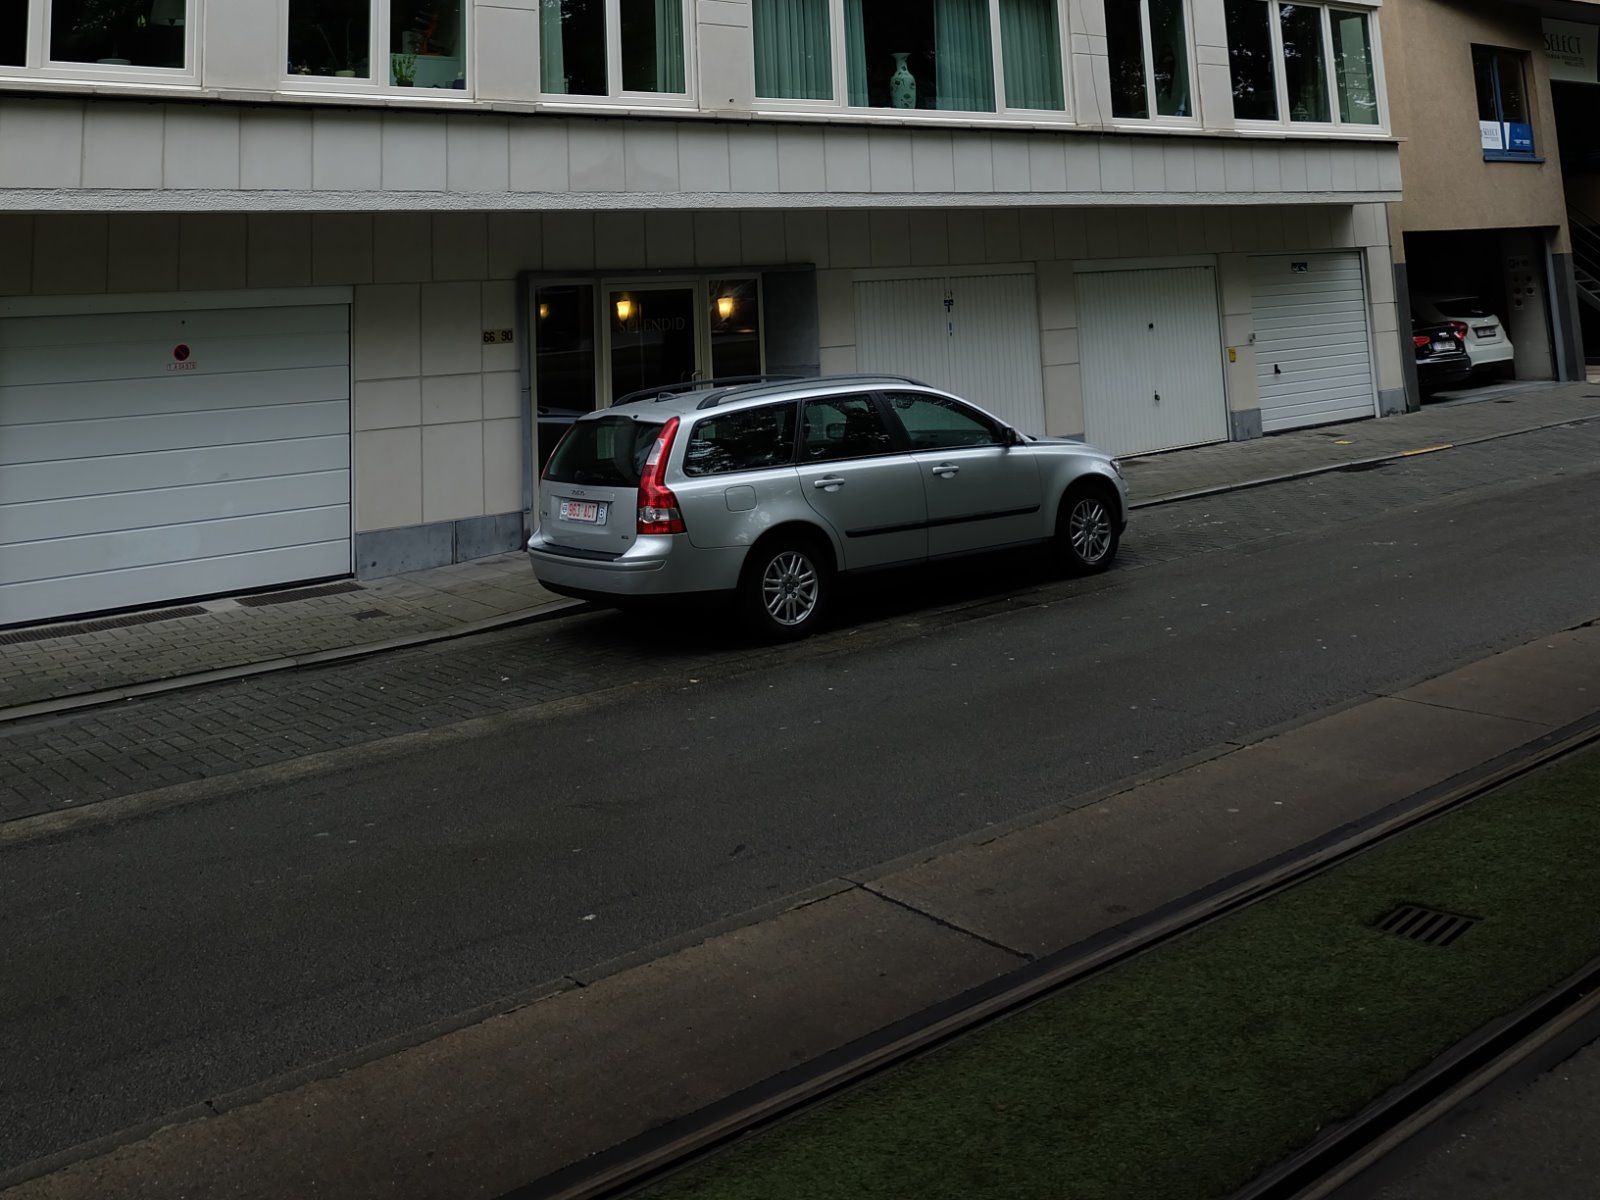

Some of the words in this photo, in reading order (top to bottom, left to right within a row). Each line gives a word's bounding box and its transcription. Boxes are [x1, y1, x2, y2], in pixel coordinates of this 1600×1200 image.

[1543, 32, 1581, 54] SELECT
[1482, 127, 1498, 137] SELECT
[618, 315, 686, 334] SPLENDID
[483, 331, 496, 343] 66
[501, 330, 513, 341] 90
